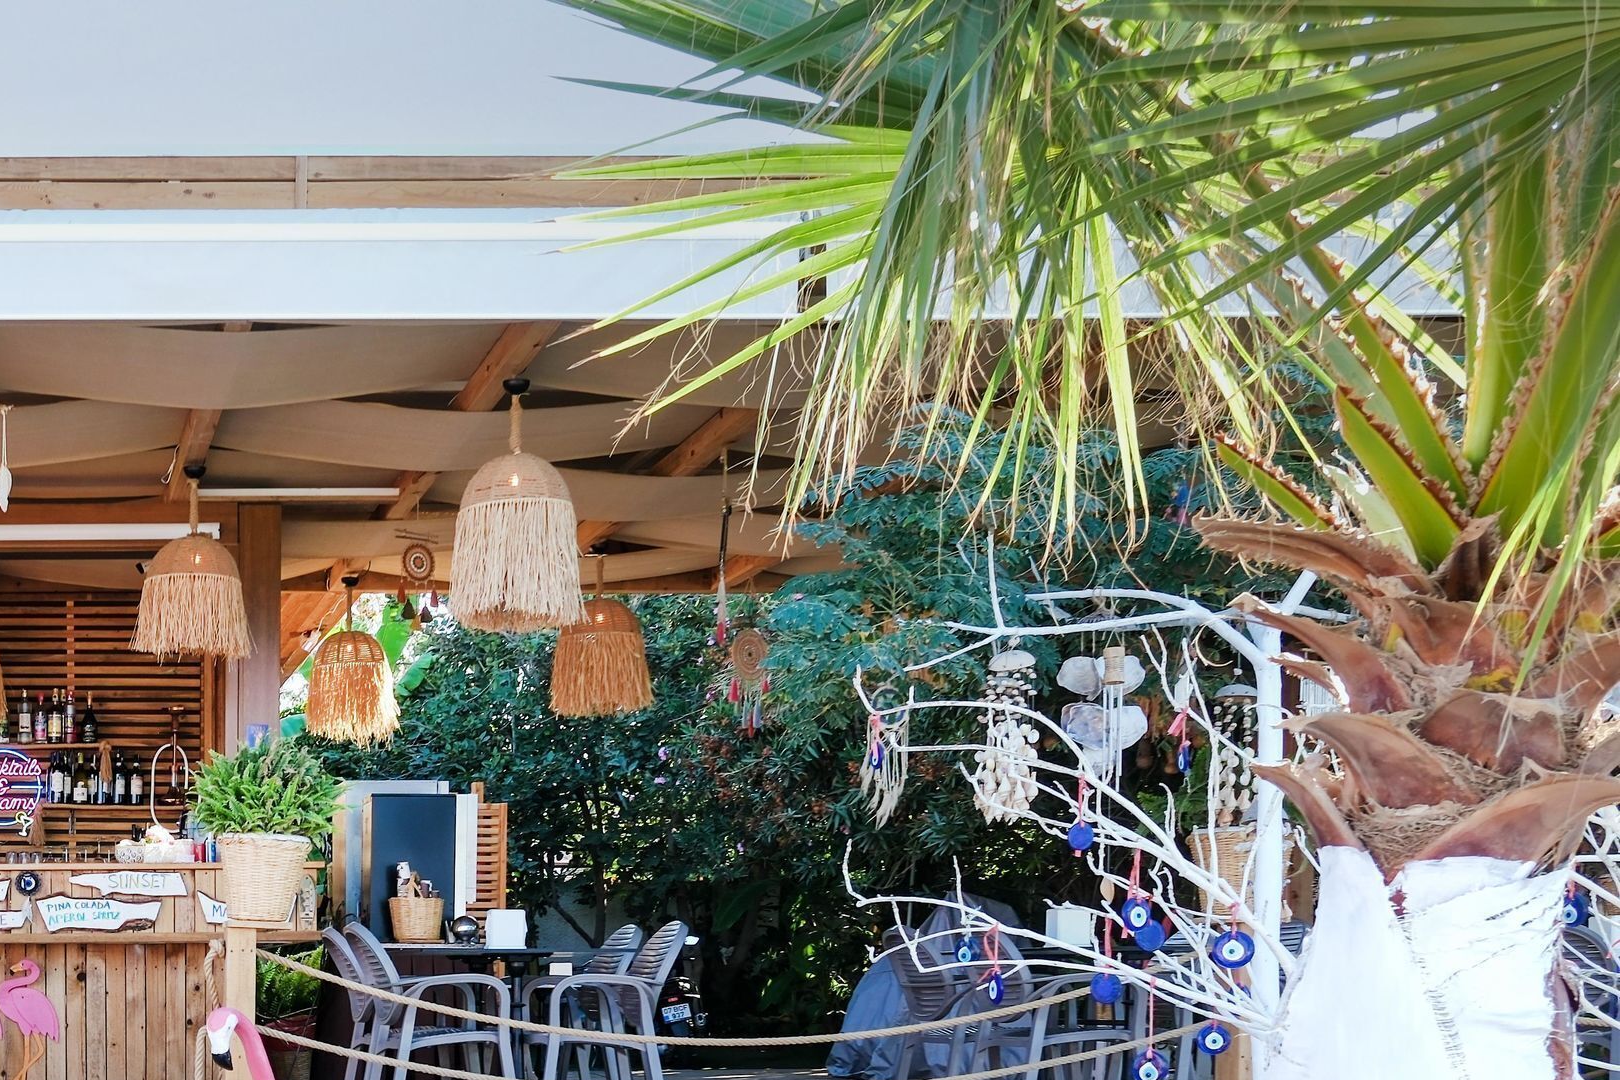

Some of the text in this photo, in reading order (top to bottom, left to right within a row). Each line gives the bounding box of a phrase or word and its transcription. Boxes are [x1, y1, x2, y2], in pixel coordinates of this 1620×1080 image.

[108, 873, 171, 888] SUNSET
[46, 901, 110, 912] PINA COLADA
